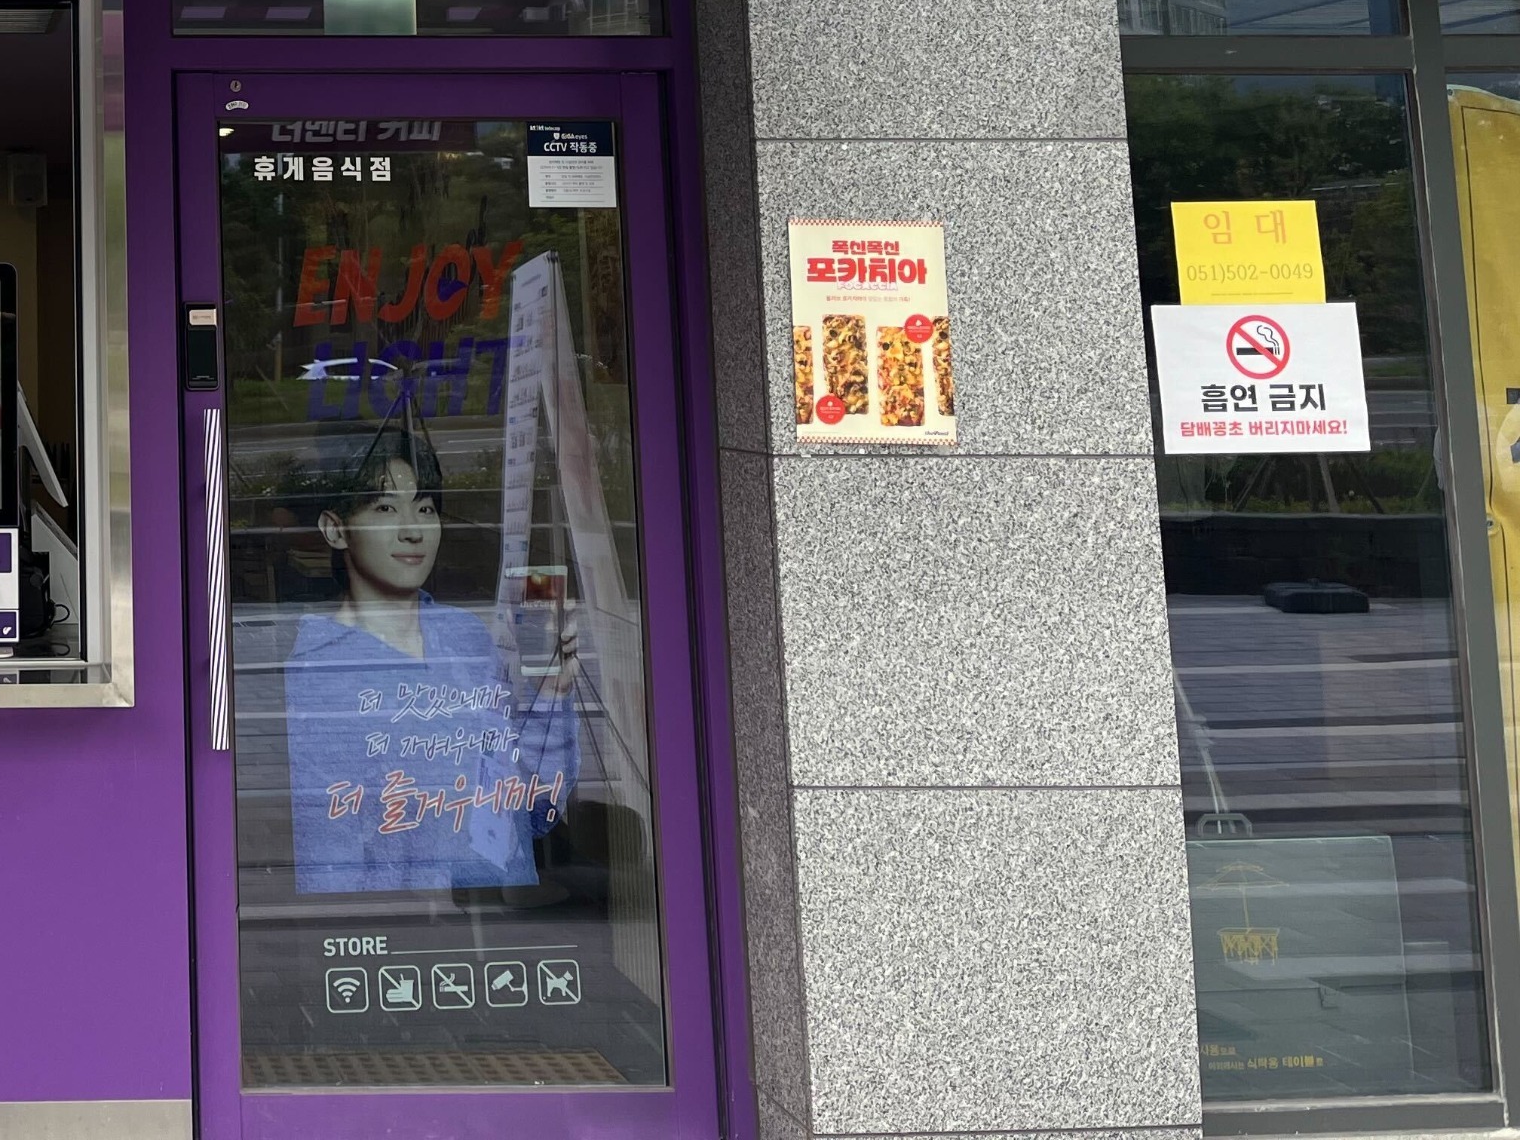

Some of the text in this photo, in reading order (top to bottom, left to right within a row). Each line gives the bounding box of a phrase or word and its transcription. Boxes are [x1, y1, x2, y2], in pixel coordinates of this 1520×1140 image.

[543, 141, 598, 153] CCTV 작동중
[253, 156, 392, 182] 휴게음식점
[831, 240, 900, 255] 폭신폭신
[806, 257, 928, 285] 포카치아
[1187, 263, 1314, 284] 051)502-0049
[1201, 383, 1327, 413] 흡연 금지
[1180, 420, 1348, 437] 담배꽁초 버리지마세요!
[358, 689, 383, 714] 더
[365, 732, 390, 758] 더
[326, 780, 365, 820] 더
[323, 936, 388, 957] STORE
